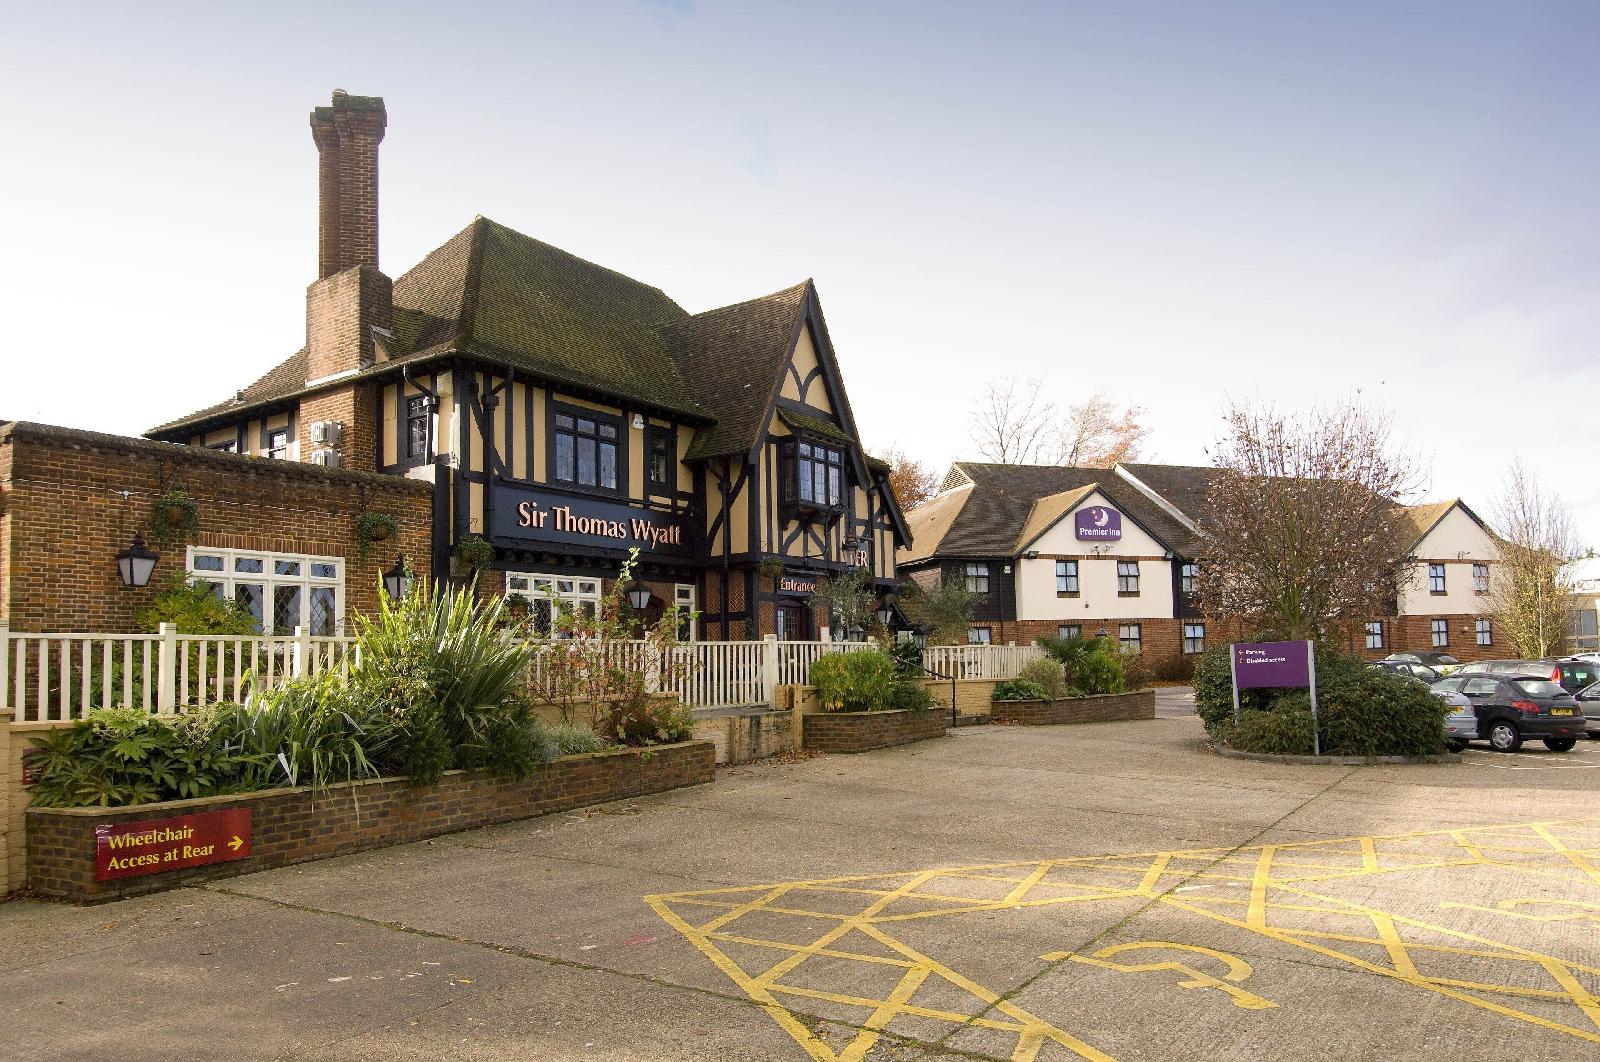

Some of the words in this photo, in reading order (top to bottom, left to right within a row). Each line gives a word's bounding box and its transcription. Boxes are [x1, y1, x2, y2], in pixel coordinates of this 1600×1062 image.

[518, 502, 548, 528] Sir
[552, 505, 627, 539] Thomas
[630, 518, 681, 550] Wyatt
[1079, 527, 1108, 536] Premier
[1109, 528, 1120, 536] Inn
[780, 577, 815, 592] Entrance
[108, 824, 195, 850] Wheelchair
[107, 853, 160, 871] Access
[163, 848, 179, 862] at
[183, 844, 215, 859] Rear
